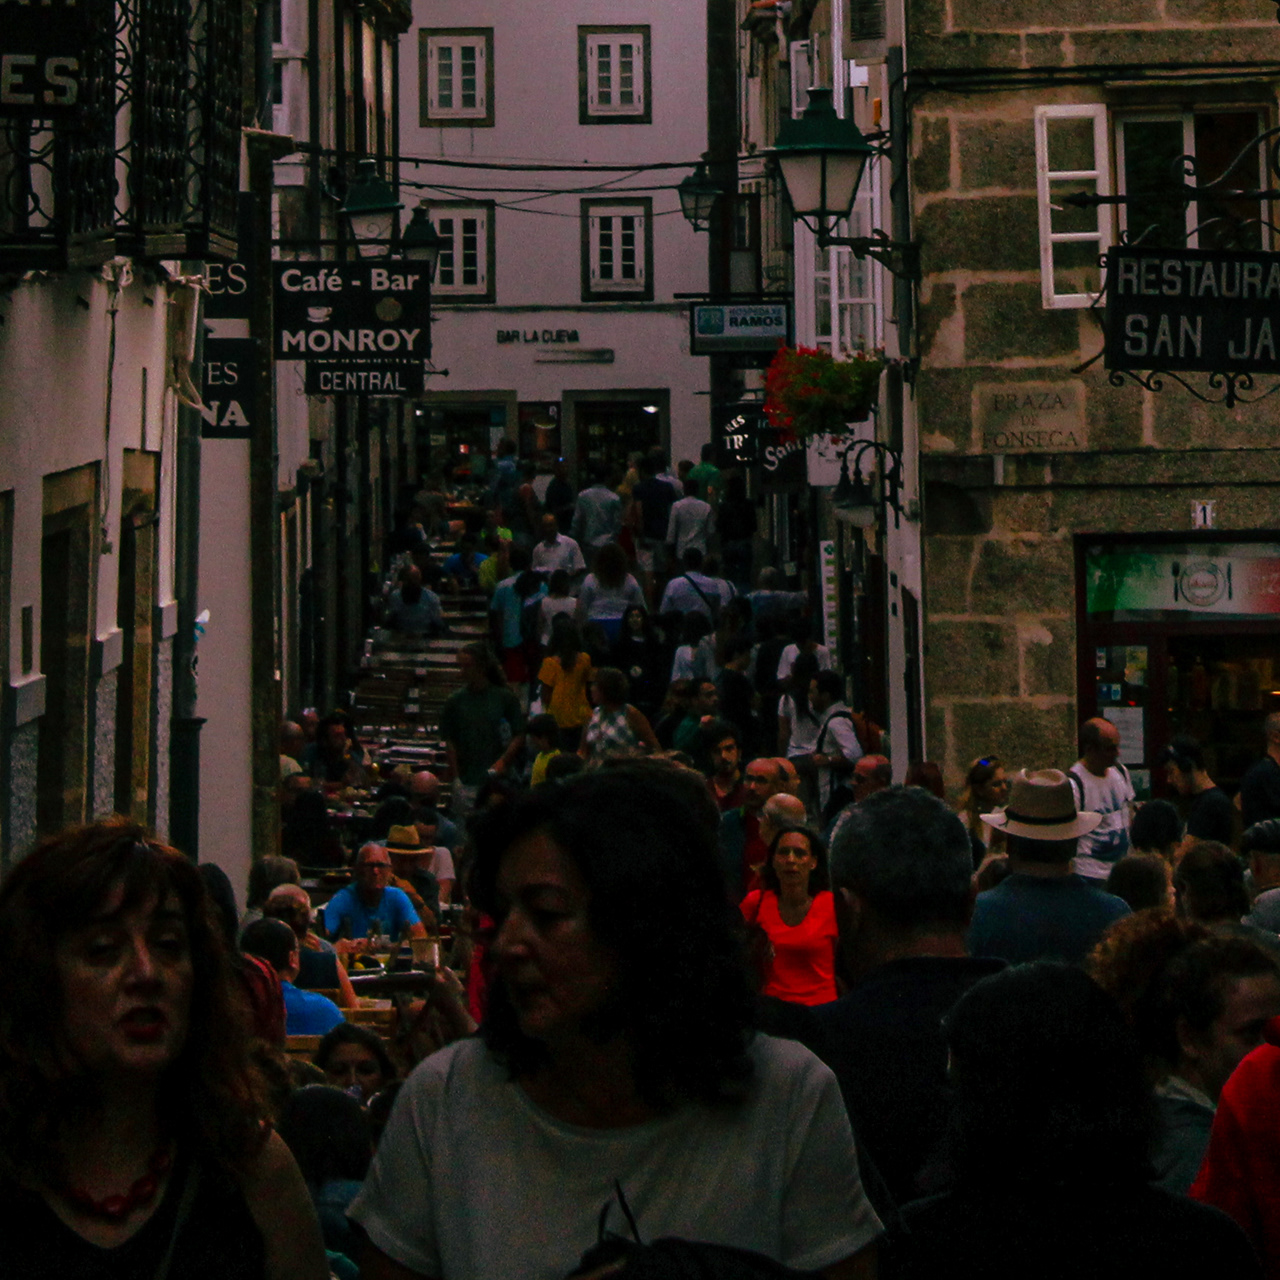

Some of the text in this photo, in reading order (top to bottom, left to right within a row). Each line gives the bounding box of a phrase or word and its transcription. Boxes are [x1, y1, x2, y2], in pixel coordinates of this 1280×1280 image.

[281, 267, 343, 293] Café
[371, 267, 420, 292] Bar
[729, 316, 783, 327] RAMOS
[281, 328, 421, 353] MONROY
[496, 329, 520, 344] BAR
[1124, 314, 1202, 357] SAN
[320, 371, 407, 392] CENTRAL
[983, 431, 1078, 448] FONSECA
